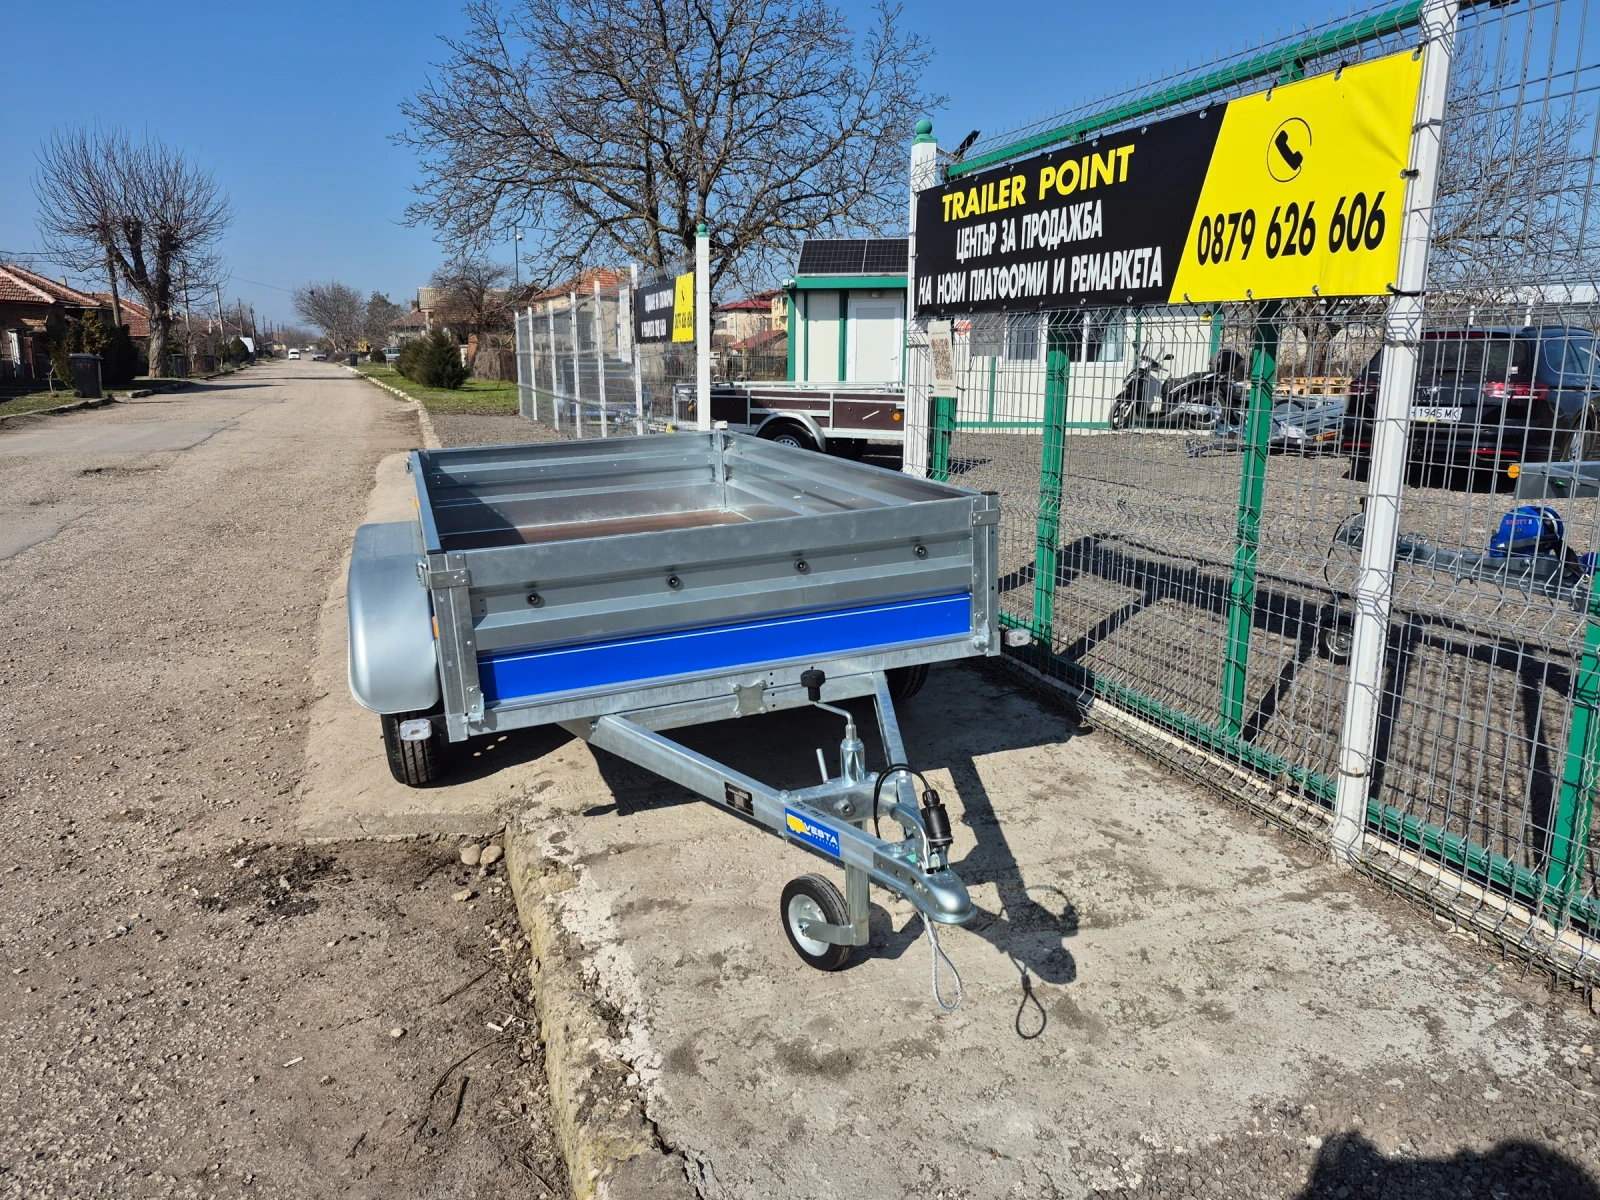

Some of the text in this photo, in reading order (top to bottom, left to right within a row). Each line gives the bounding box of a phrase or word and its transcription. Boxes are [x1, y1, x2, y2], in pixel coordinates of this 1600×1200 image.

[942, 144, 1135, 222] TRAILER POINT
[956, 200, 1103, 264] ЦЕНТЪР ЗА ПРОДАЖБА
[1197, 191, 1386, 266] 0879 626 606
[918, 246, 1163, 305] НА НОВИ ПЛАТФОРМИ И РЕМАРКЕТА
[1419, 408, 1443, 418] 1945
[803, 821, 838, 846] VESTA
